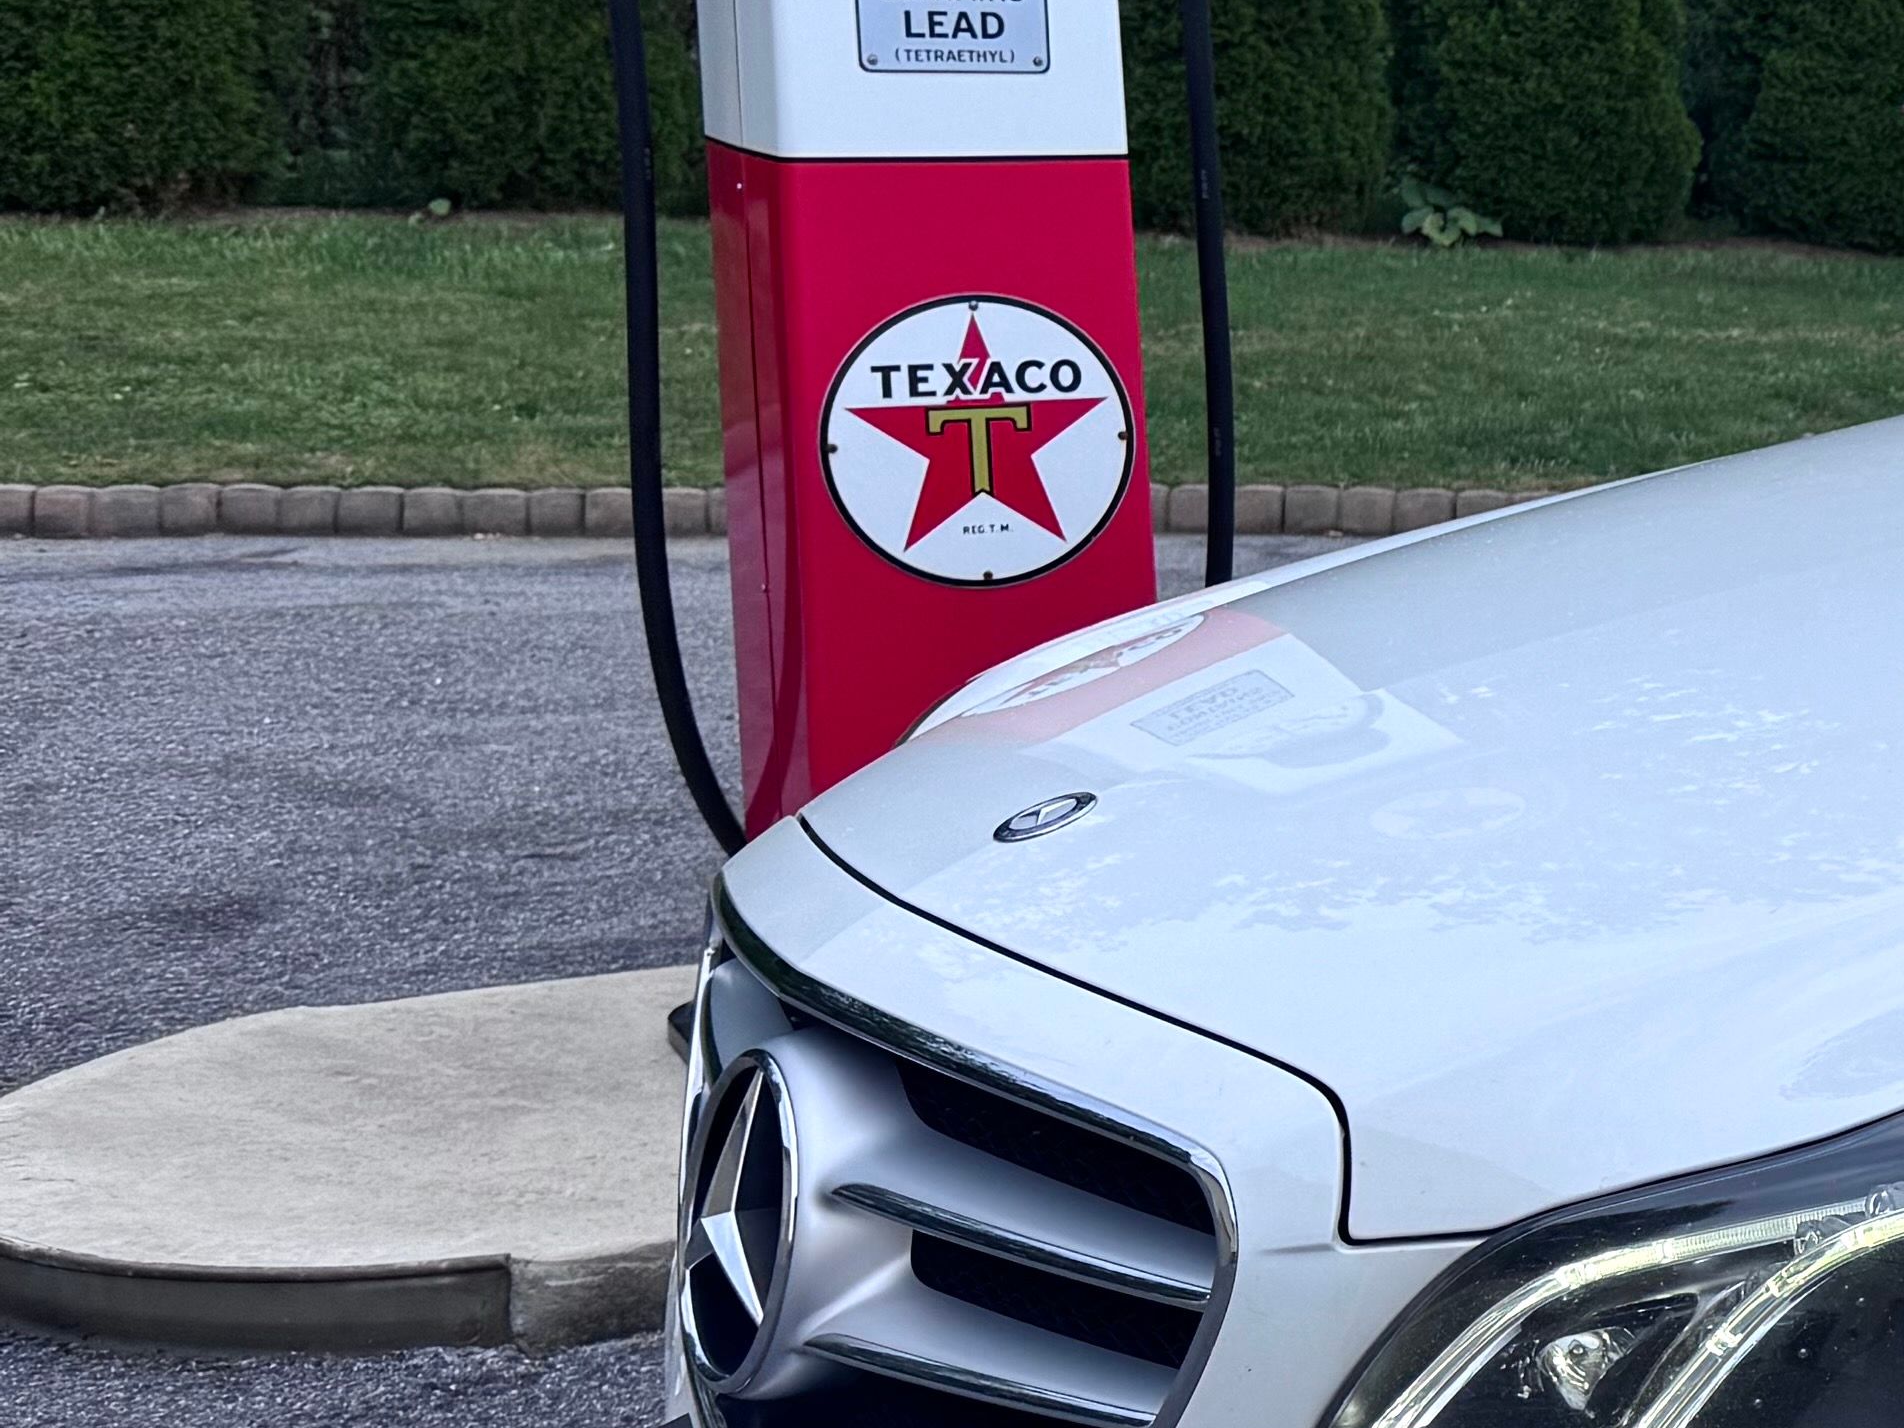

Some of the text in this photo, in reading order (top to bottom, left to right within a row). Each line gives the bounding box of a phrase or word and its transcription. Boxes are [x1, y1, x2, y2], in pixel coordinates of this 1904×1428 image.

[903, 10, 1005, 40] LEAD
[870, 358, 1082, 400] TEXACO
[925, 403, 1033, 497] T
